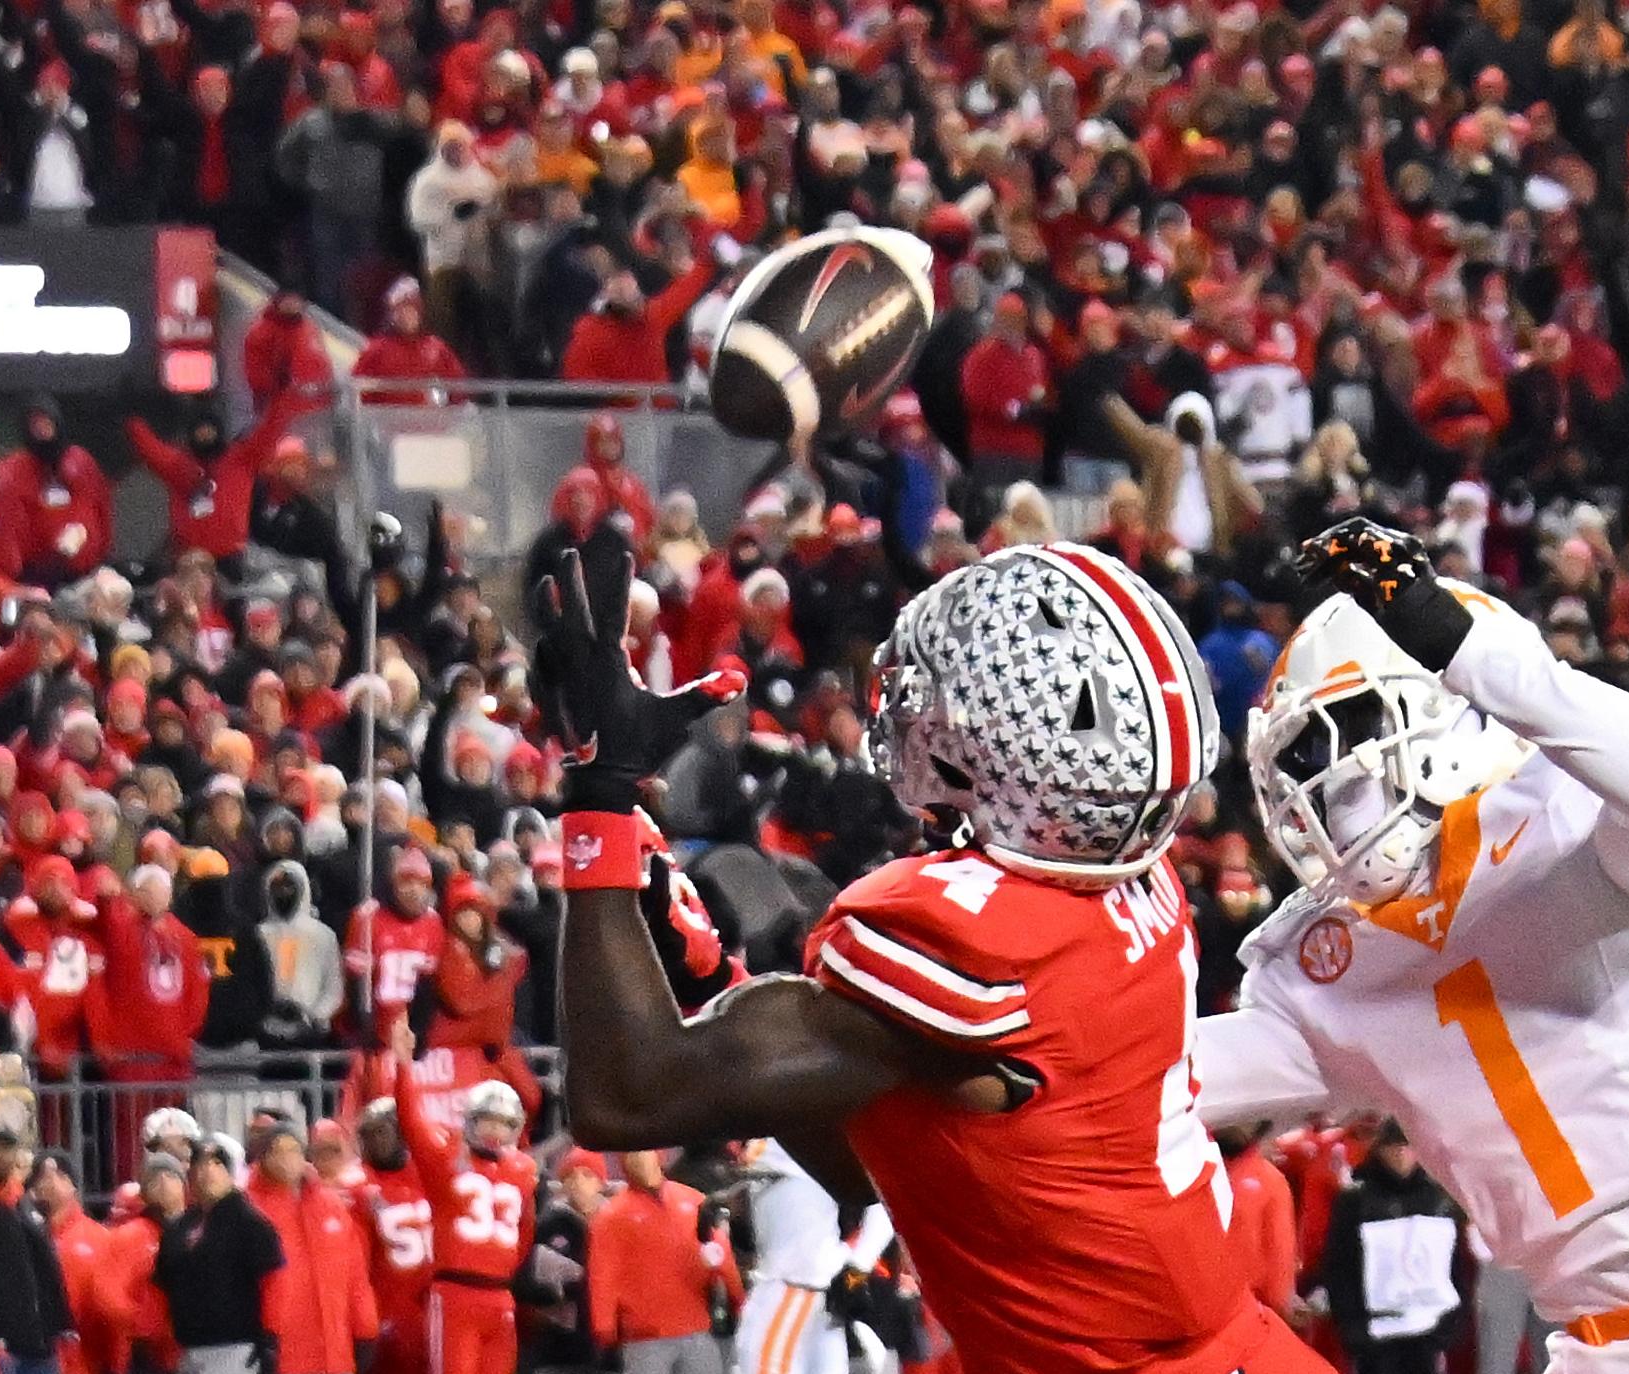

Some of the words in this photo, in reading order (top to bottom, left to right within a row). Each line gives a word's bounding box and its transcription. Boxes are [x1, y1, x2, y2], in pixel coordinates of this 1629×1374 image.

[1380, 580, 1398, 602] T
[1416, 902, 1445, 942] T
[197, 936, 235, 978] T
[1434, 959, 1593, 1218] 1
[453, 1171, 520, 1248] 33
